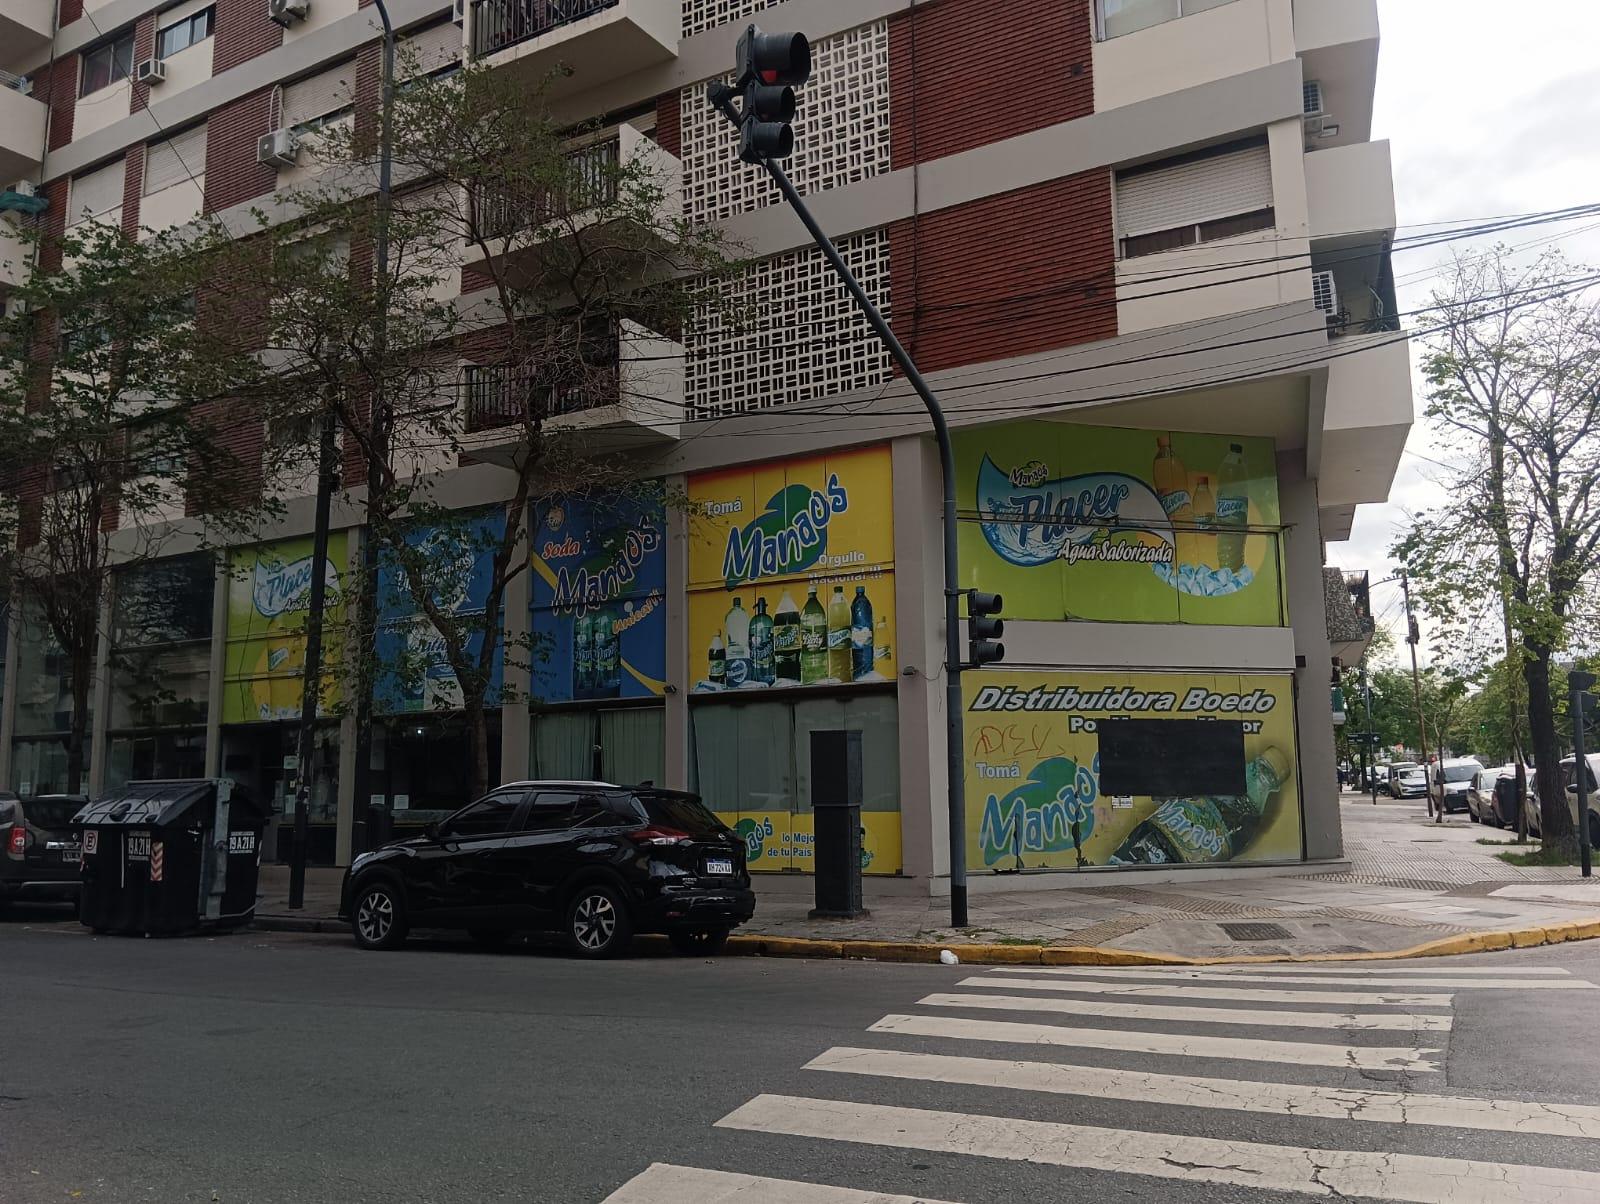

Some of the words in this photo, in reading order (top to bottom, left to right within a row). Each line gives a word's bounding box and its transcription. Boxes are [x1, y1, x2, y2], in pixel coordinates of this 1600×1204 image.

[1008, 464, 1049, 487] Manaos
[705, 495, 743, 517] Tomá
[1009, 480, 1131, 548] Placer
[722, 472, 851, 581] Manaos
[818, 550, 866, 568] Orgullo
[1057, 538, 1096, 566] Agua
[1096, 538, 1174, 564] Saborizada
[552, 516, 661, 619] Manaos
[266, 562, 312, 608] Place
[969, 685, 1176, 712] Distribuidora
[1177, 687, 1277, 713] Boedo
[1068, 715, 1099, 734] Po
[975, 760, 1022, 779] Tomá
[793, 832, 815, 844] Mejo
[768, 848, 778, 857] de
[781, 847, 790, 857] tu
